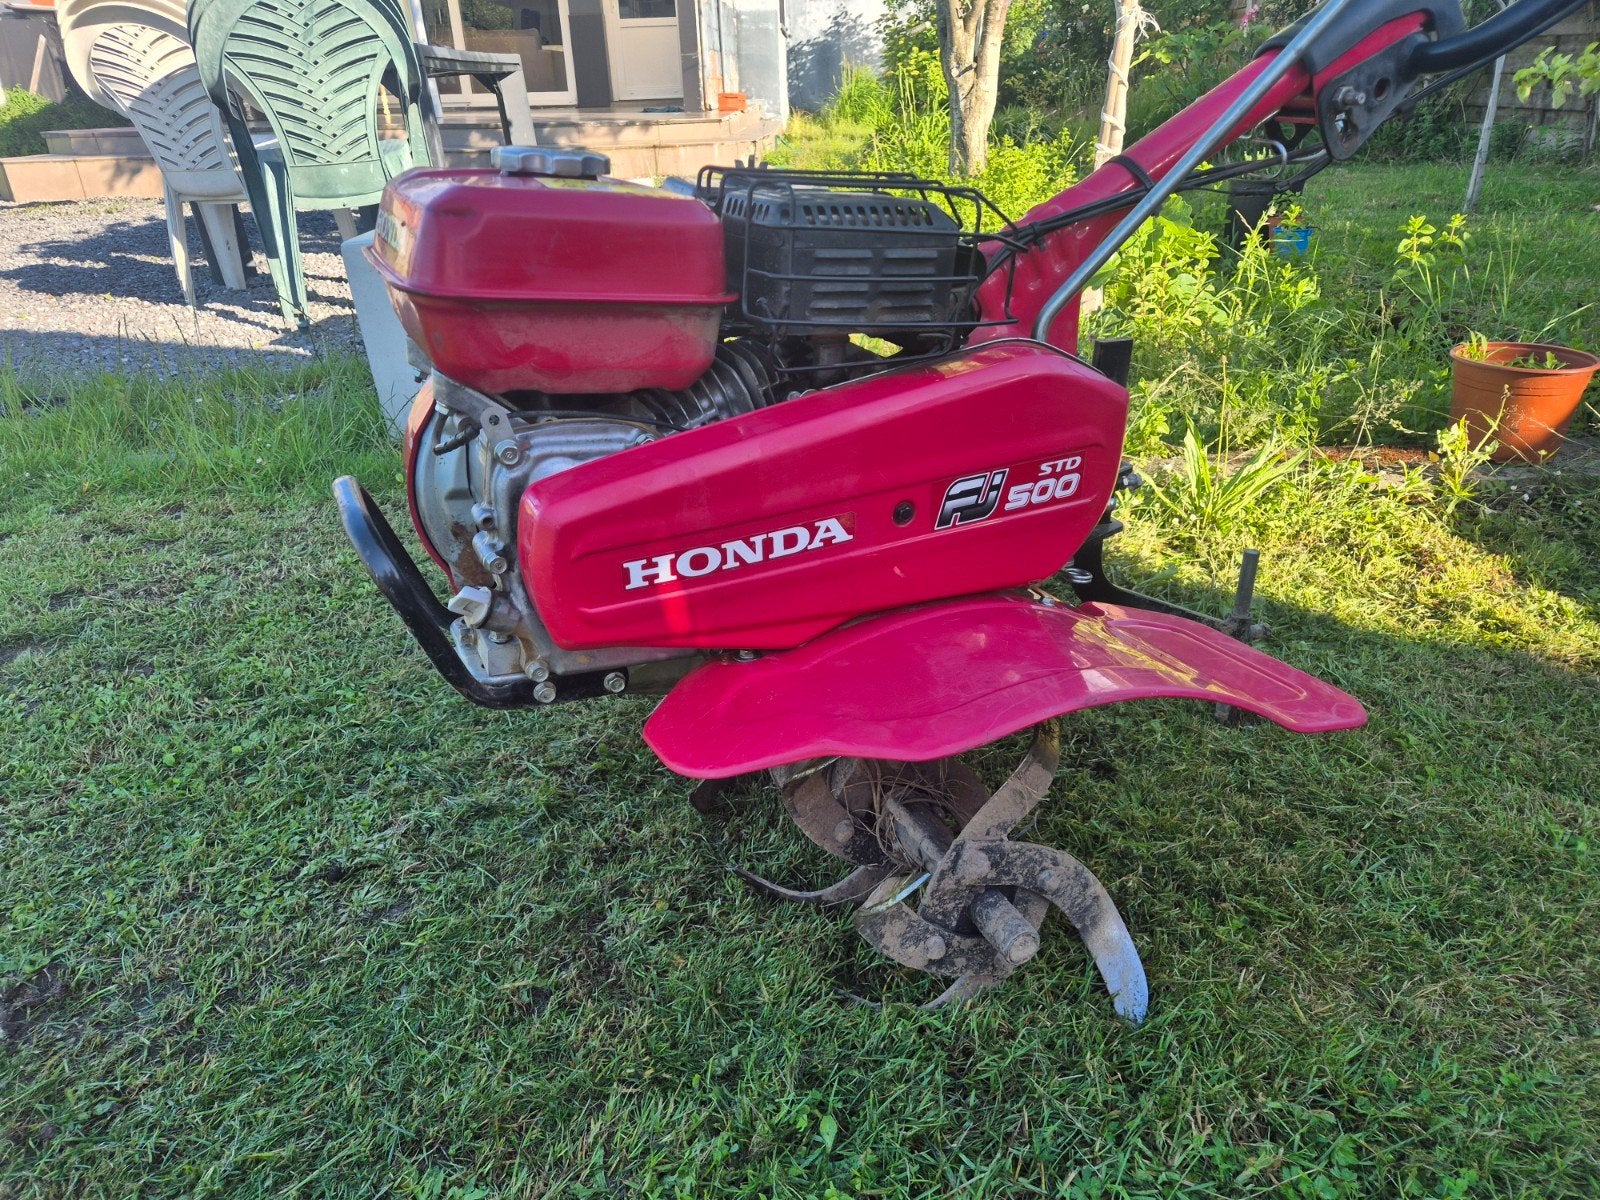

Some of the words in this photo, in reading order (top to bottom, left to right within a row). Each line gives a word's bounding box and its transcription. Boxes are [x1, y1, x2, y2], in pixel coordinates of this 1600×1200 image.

[1038, 456, 1082, 476] STD
[1005, 473, 1081, 511] 500
[623, 518, 853, 590] HONDA
